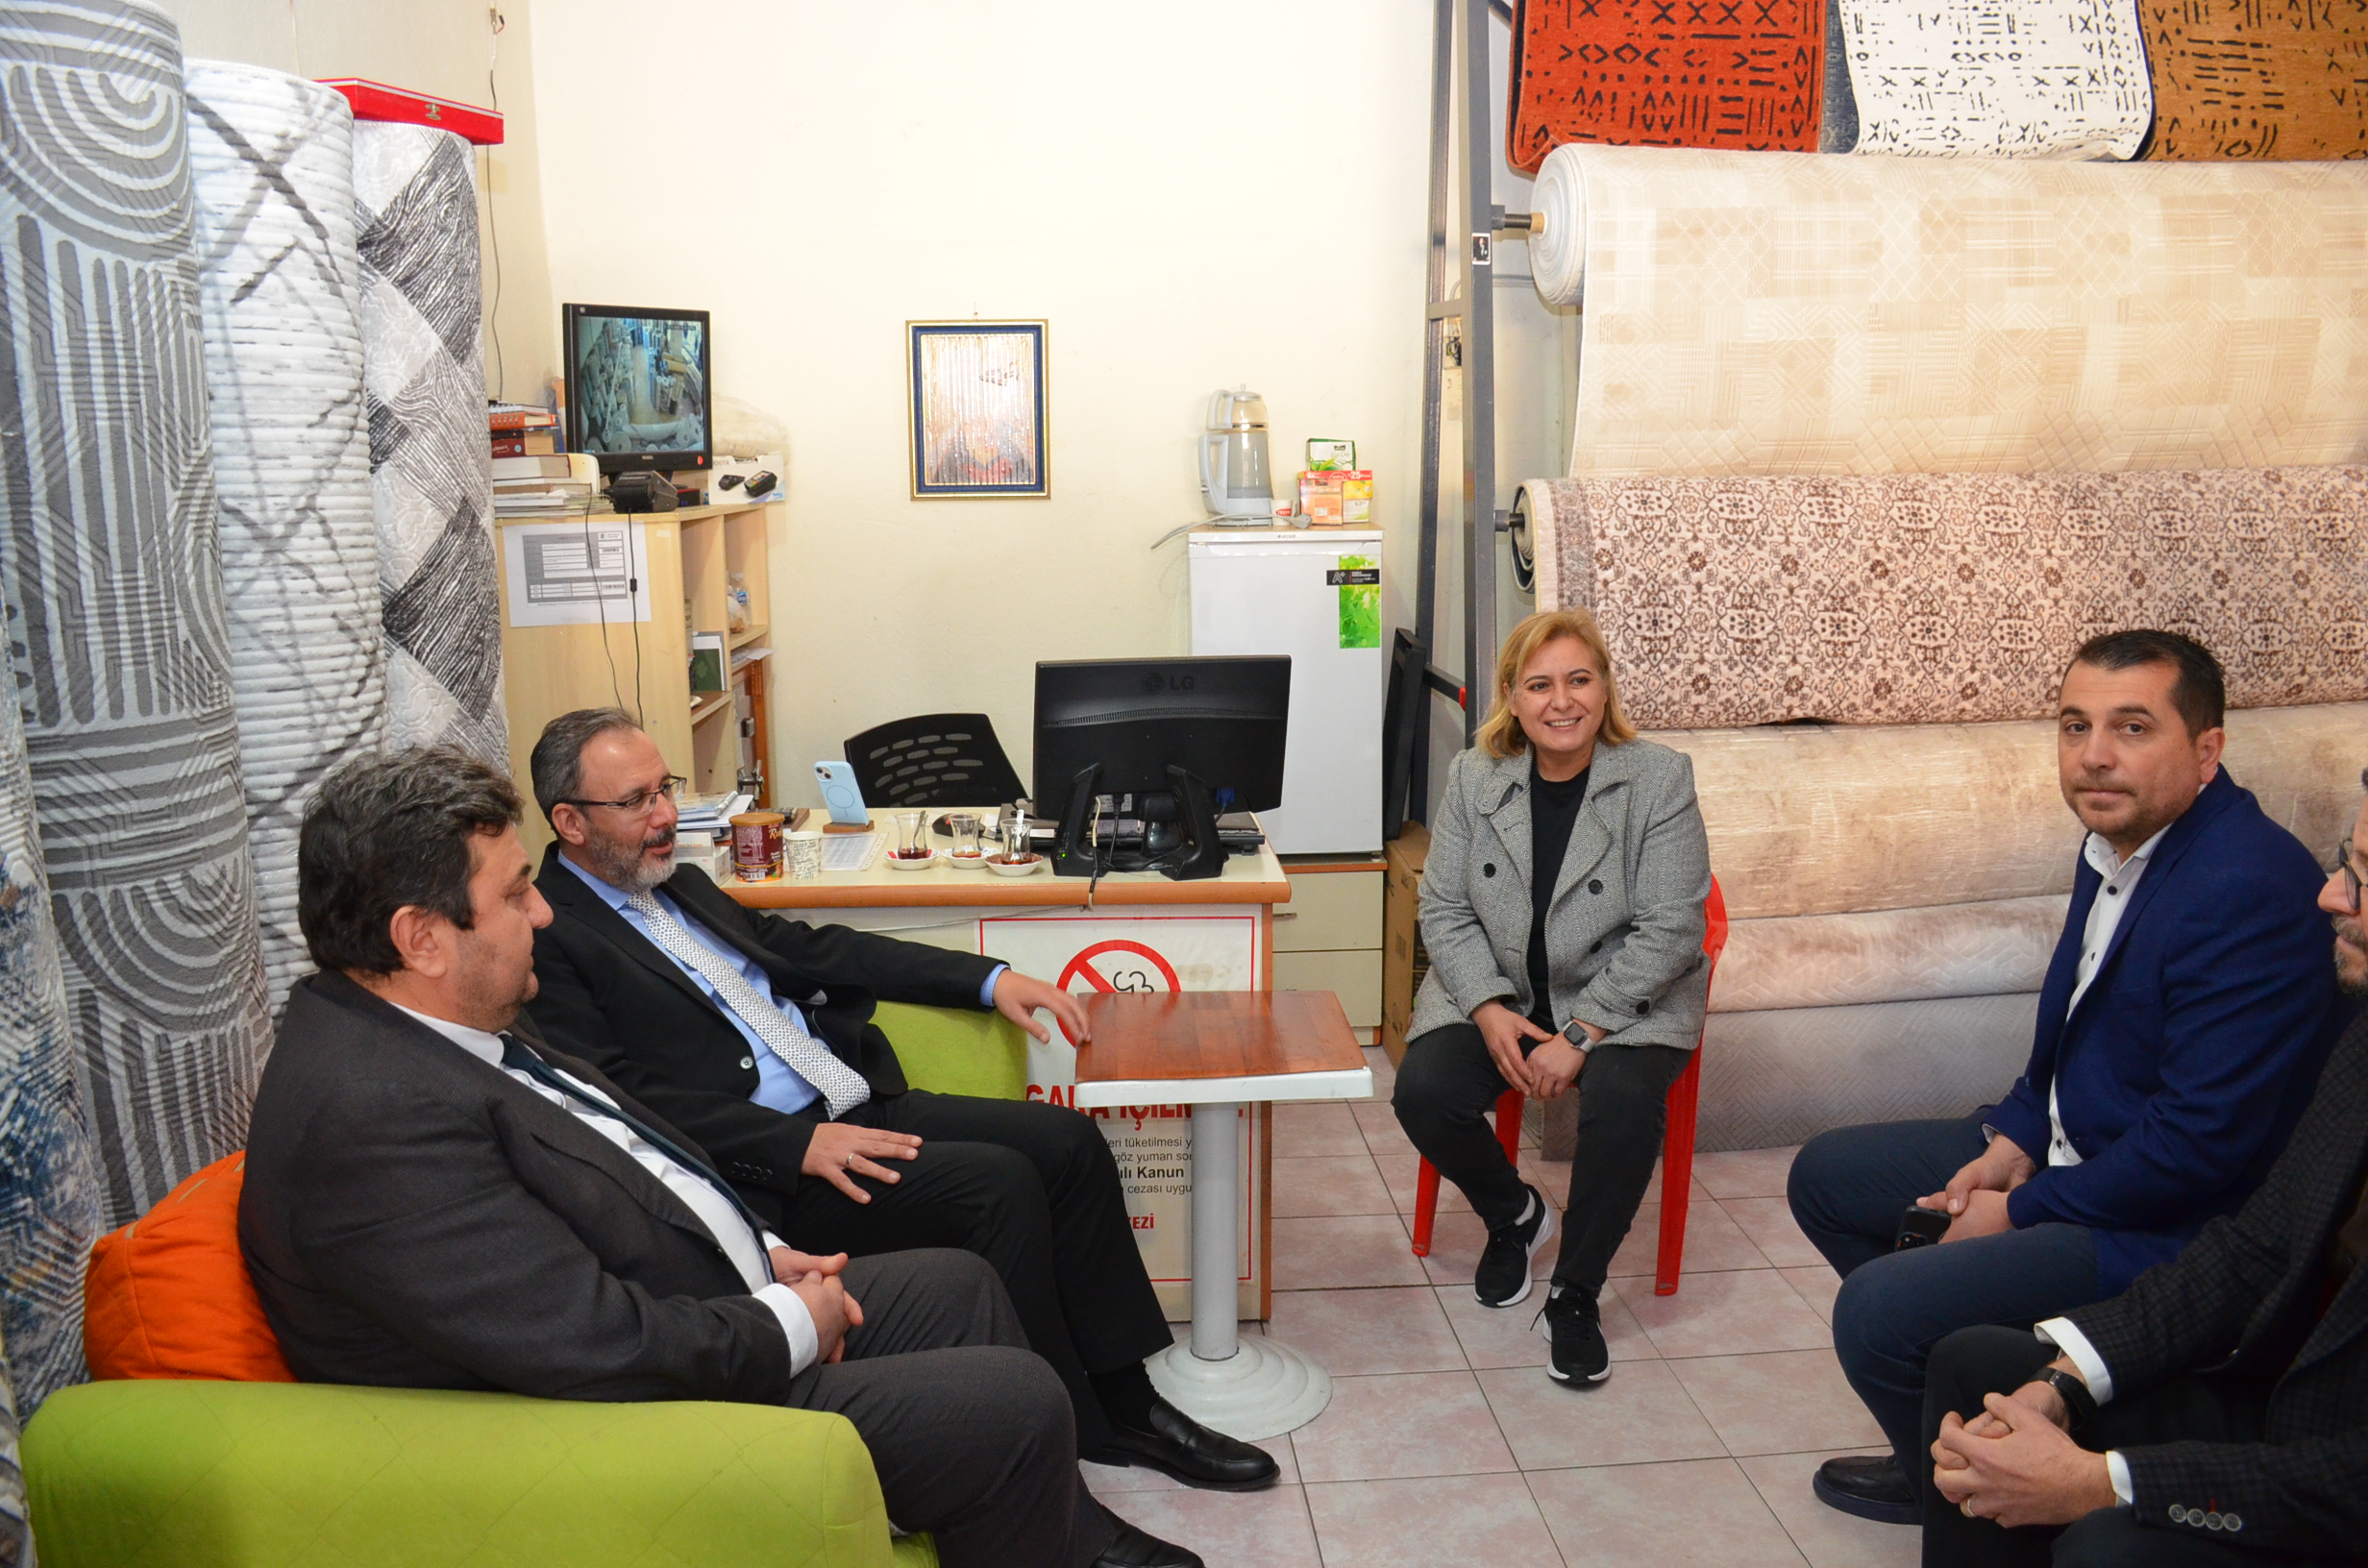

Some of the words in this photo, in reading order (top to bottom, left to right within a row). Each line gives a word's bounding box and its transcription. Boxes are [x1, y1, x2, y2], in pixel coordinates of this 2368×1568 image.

[1170, 675, 1195, 691] LG
[1125, 1137, 1183, 1148] tüketilmesi
[1115, 1152, 1133, 1164] göz
[1137, 1153, 1173, 1164] yuman
[1137, 1165, 1184, 1179] Kanun
[1127, 1185, 1163, 1194] cezası
